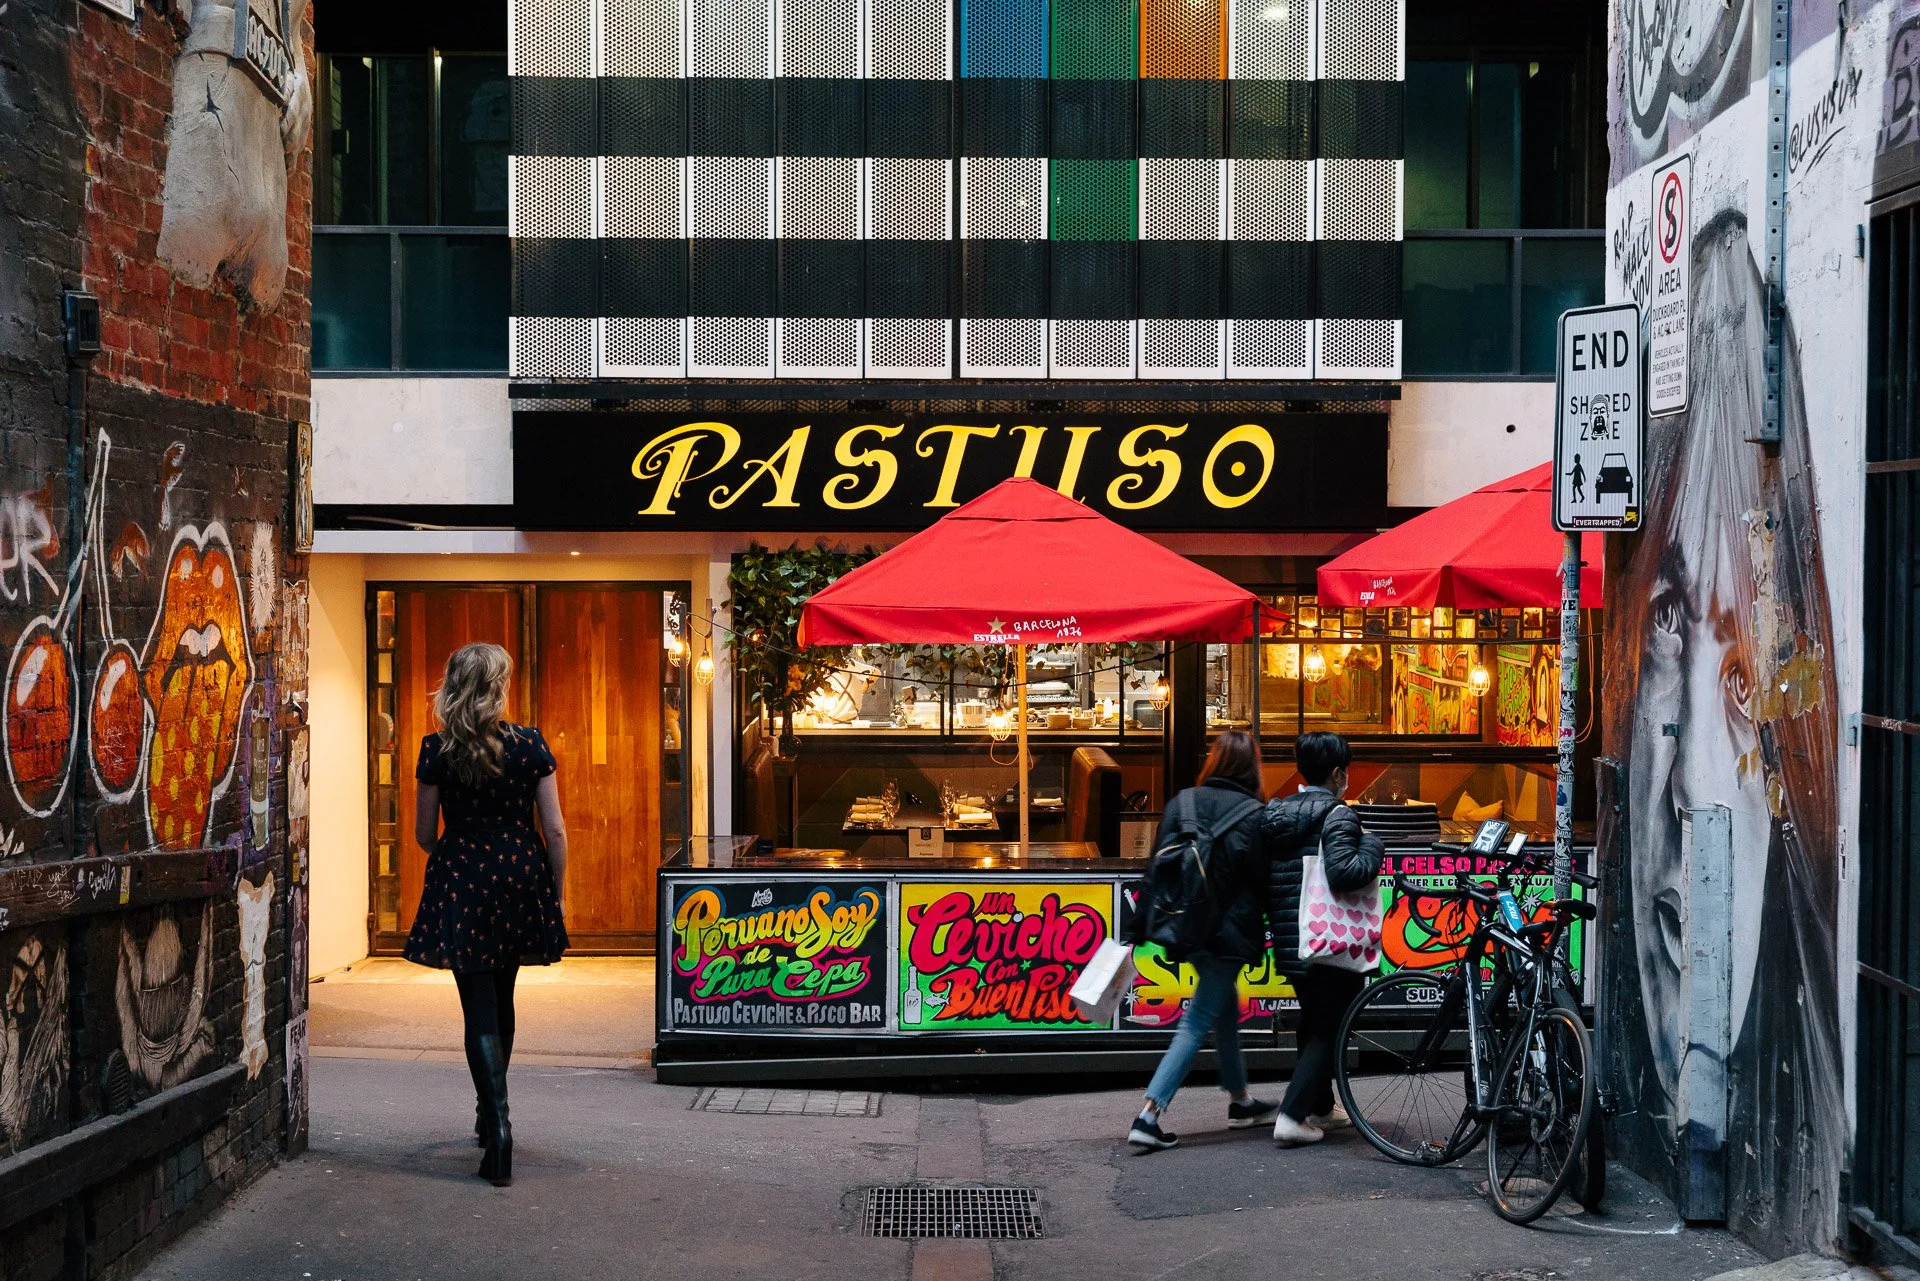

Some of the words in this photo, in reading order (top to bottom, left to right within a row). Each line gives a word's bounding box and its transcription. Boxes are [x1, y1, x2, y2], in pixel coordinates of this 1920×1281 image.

[1658, 267, 1682, 298] AREA
[1652, 301, 1679, 323] DUCKBOARD
[1680, 299, 1686, 314] PL
[1673, 316, 1685, 334] LANE
[1572, 330, 1629, 371] END
[1570, 392, 1631, 415] SHED
[1580, 420, 1621, 441] ZE
[631, 421, 1275, 516] PASTUSO
[1013, 615, 1078, 632] BARCELONA
[1057, 627, 1082, 638] 1876
[973, 633, 1020, 642] ESTRELLA
[1401, 856, 1471, 875] CELSO
[1379, 878, 1429, 888] ANHER
[1433, 878, 1445, 887] EL
[974, 891, 1016, 916] un
[674, 888, 811, 971] Peruano
[795, 890, 880, 959] Soy
[907, 891, 1105, 974] Ceviche
[740, 944, 773, 965] de
[695, 954, 773, 998] Pura
[771, 955, 866, 997] Cepa
[984, 959, 1019, 984] Con
[929, 967, 1027, 1021] Buen
[1019, 964, 1091, 1023] Pisc
[674, 998, 730, 1024] PASTUSO
[732, 1000, 793, 1025] CEVICHE
[795, 1006, 807, 1024] &
[807, 1002, 847, 1025] PISCO
[850, 1002, 881, 1023] BAR
[290, 1018, 307, 1047] FEAR
